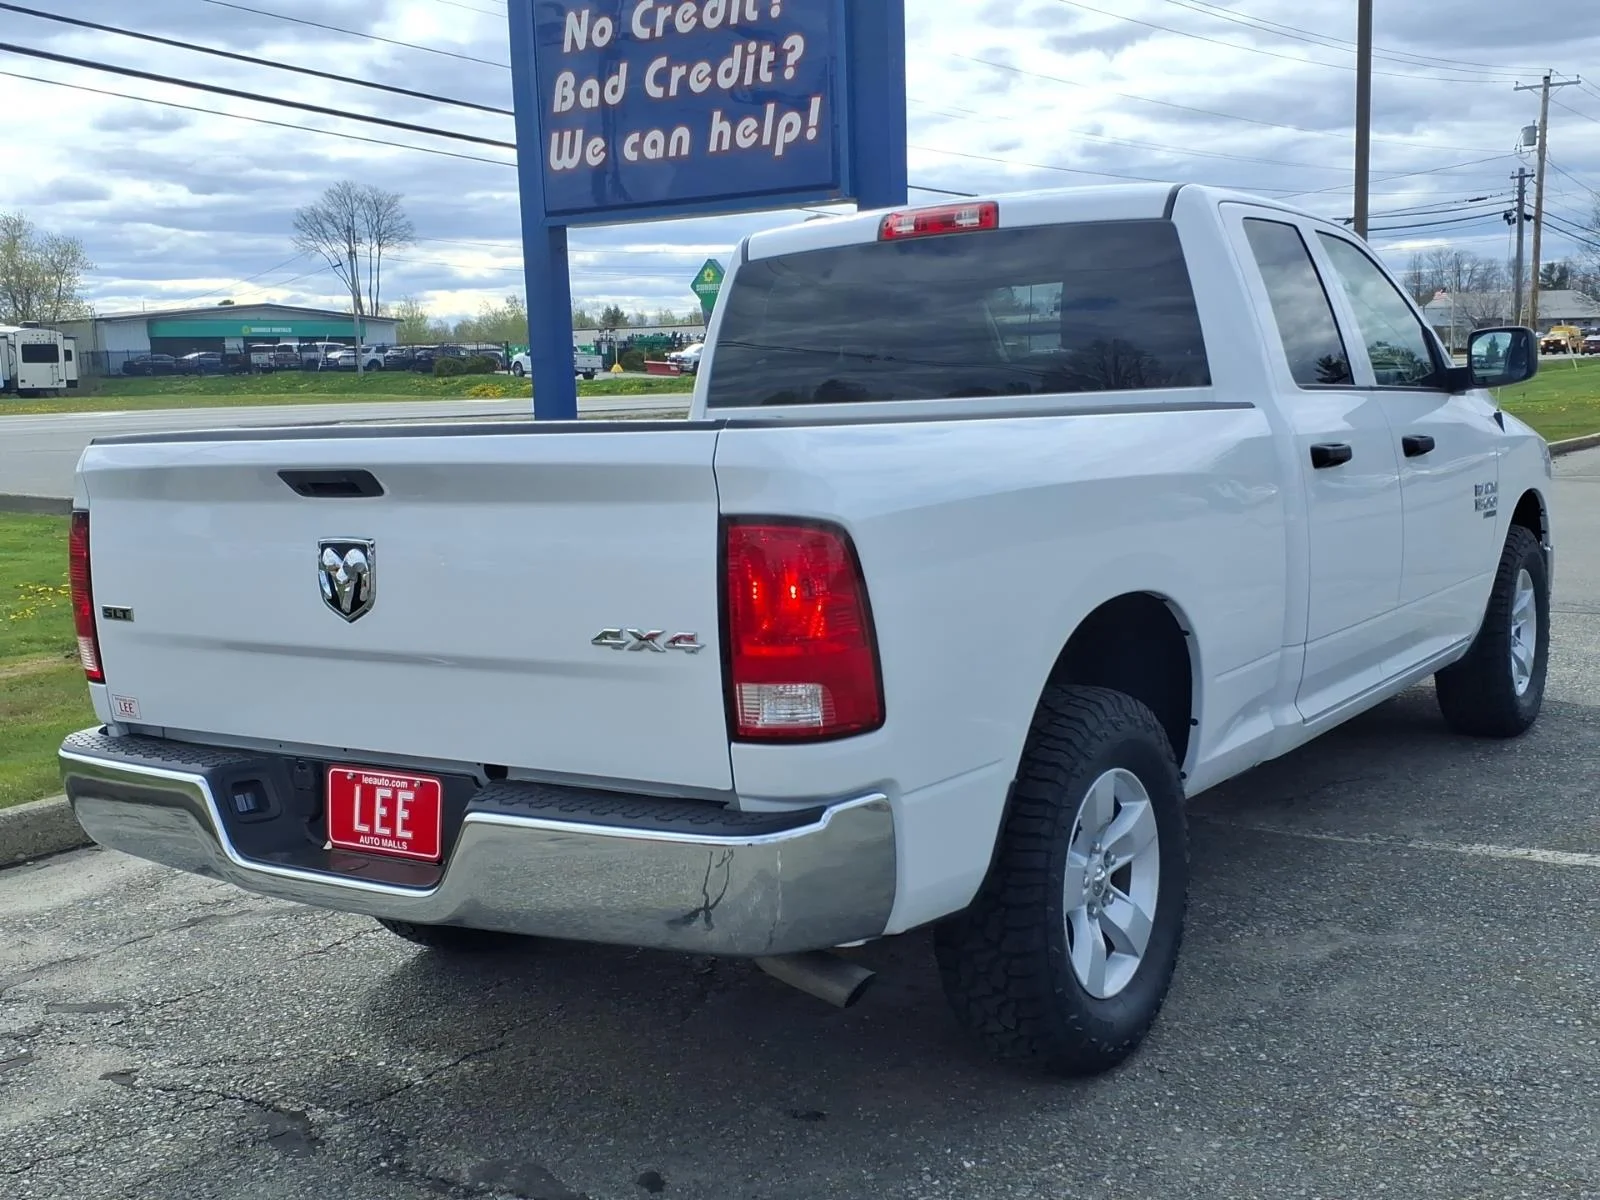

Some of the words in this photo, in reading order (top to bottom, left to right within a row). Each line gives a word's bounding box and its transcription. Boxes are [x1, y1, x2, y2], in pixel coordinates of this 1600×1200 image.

[562, 9, 613, 53] No
[553, 62, 627, 113] Bad
[644, 34, 804, 98] Credit?
[549, 128, 606, 170] We
[623, 126, 690, 161] can
[708, 96, 821, 156] help!
[102, 607, 132, 620] SLT
[591, 628, 706, 654] 4X4
[119, 701, 134, 714] LEE
[361, 774, 408, 789] leeauto.com
[353, 784, 415, 840] LEE
[359, 835, 380, 846] AUTO
[381, 839, 408, 851] MALLS
